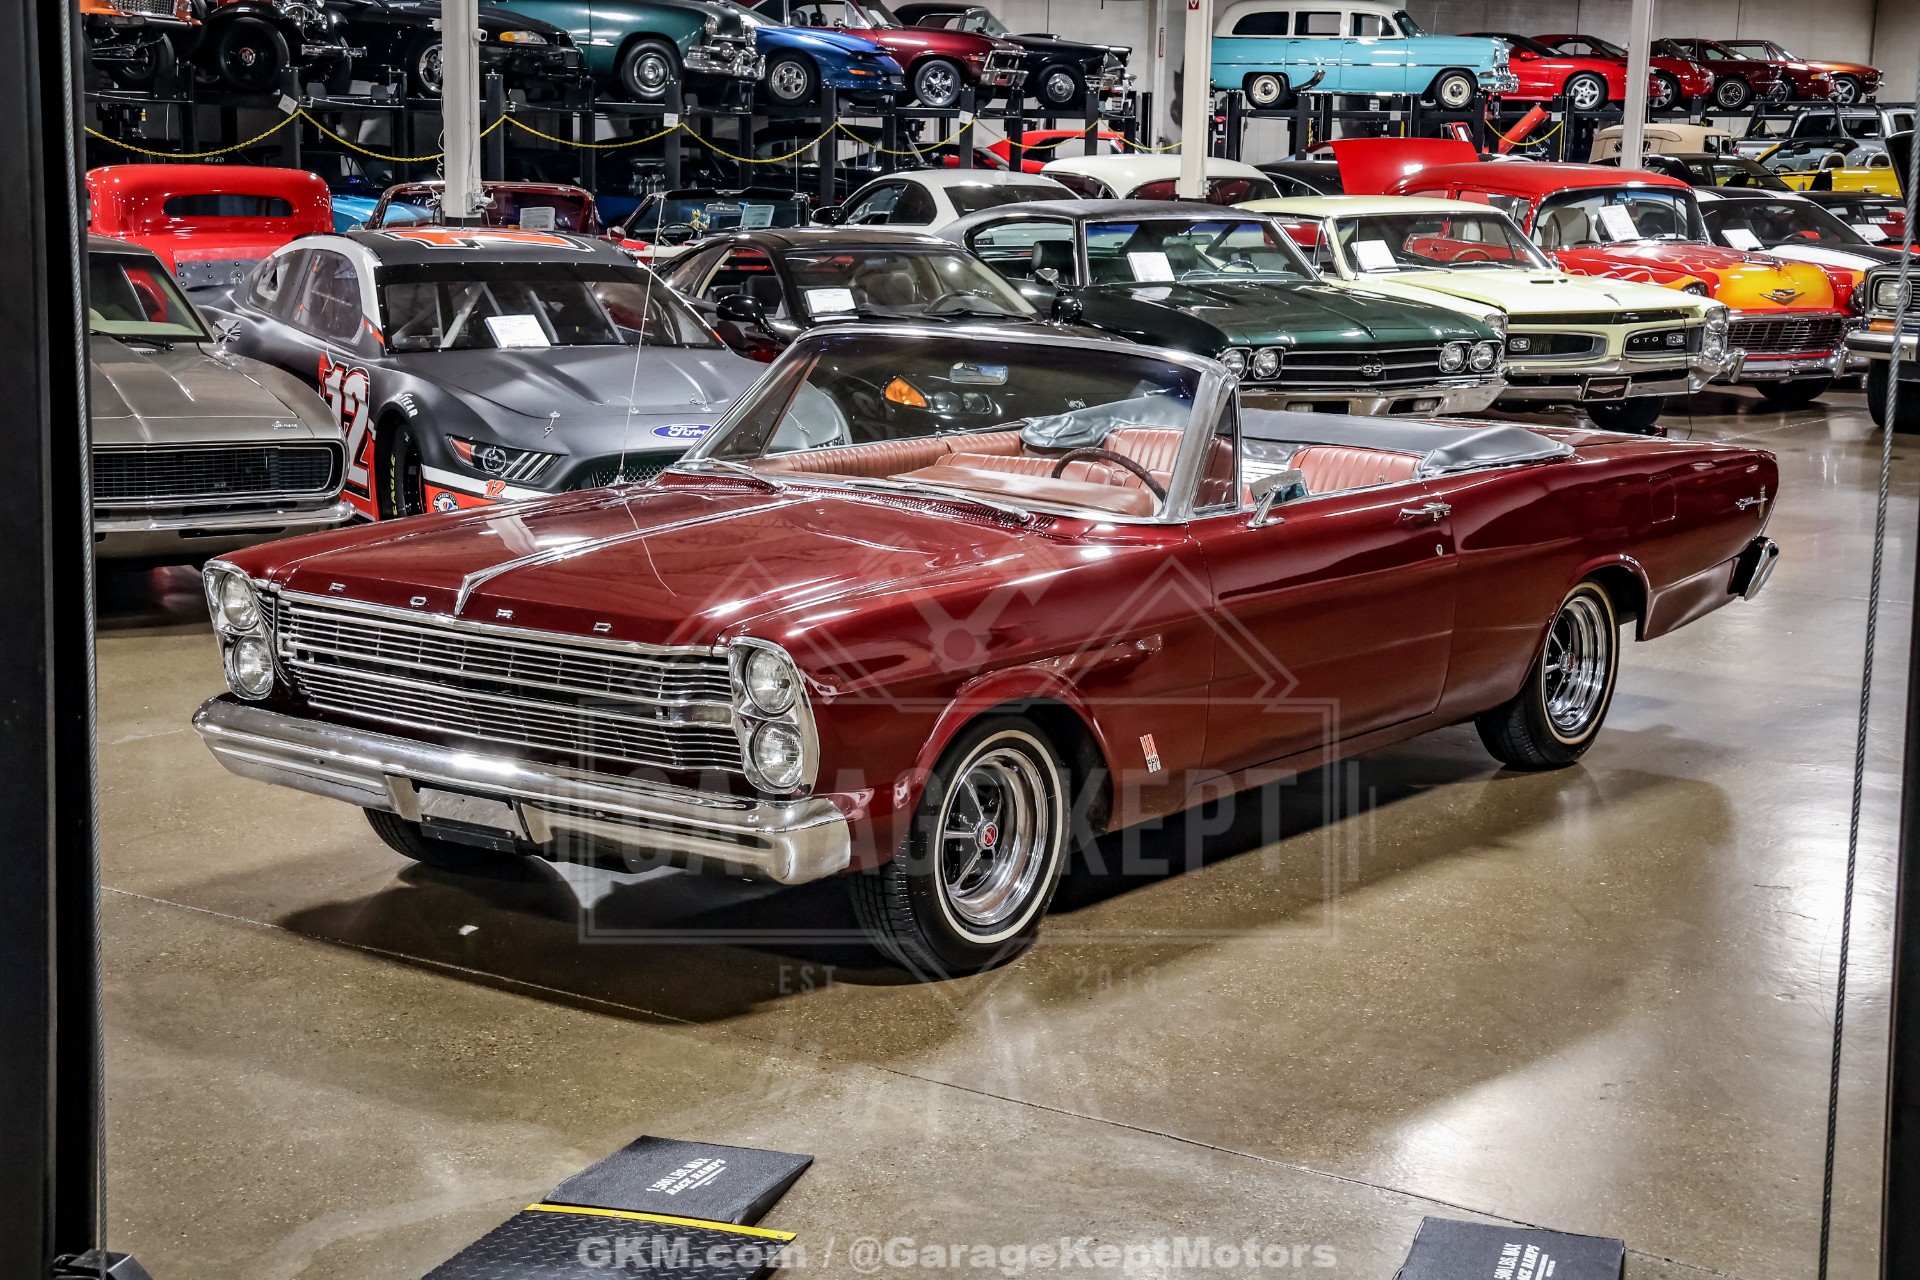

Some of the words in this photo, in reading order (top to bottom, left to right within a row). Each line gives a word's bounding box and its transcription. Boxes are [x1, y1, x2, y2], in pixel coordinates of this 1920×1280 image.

[1632, 336, 1659, 345] GTO
[1361, 364, 1382, 374] SS
[322, 362, 371, 491] 12
[483, 480, 507, 499] 12
